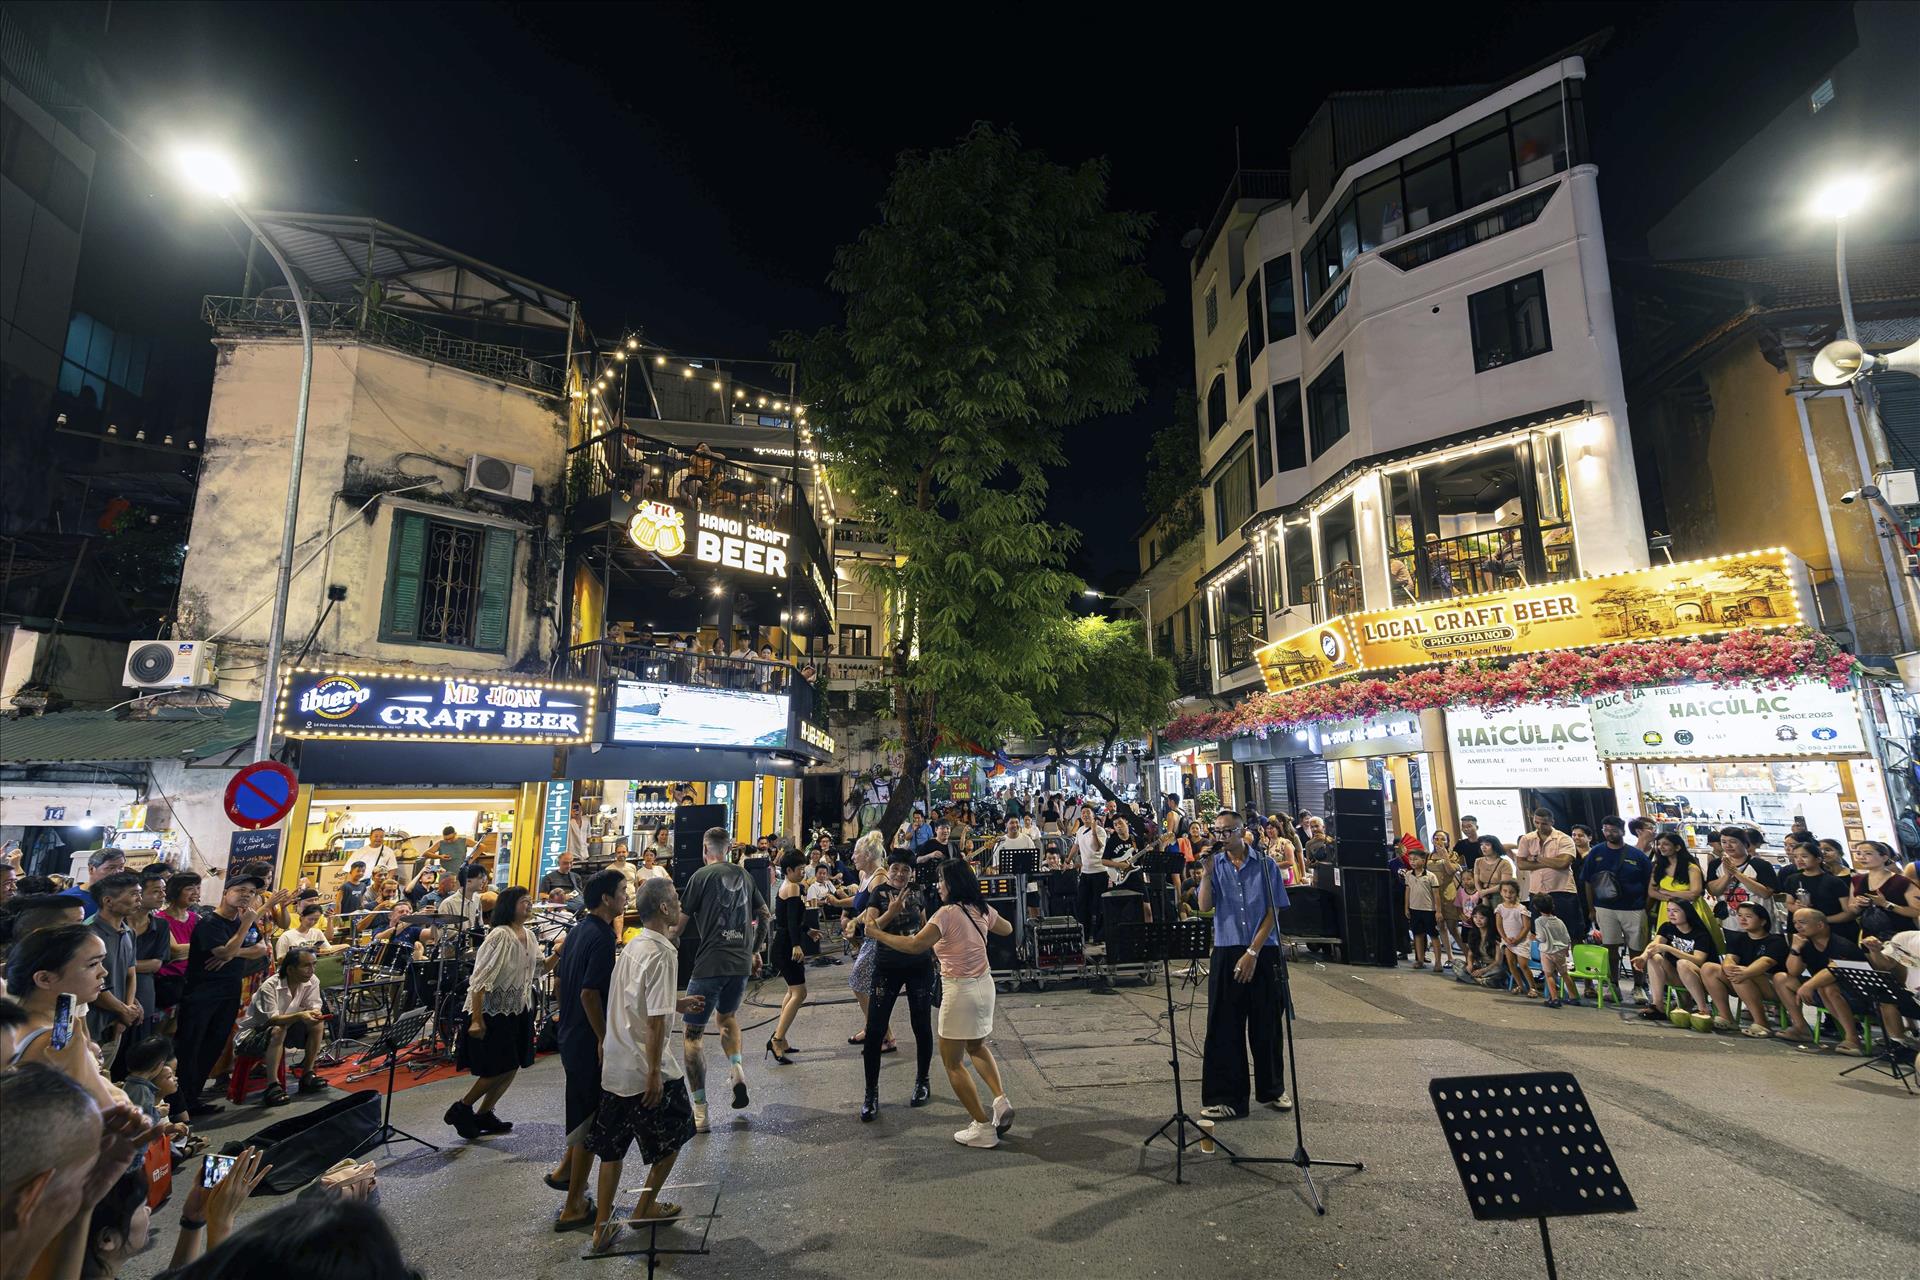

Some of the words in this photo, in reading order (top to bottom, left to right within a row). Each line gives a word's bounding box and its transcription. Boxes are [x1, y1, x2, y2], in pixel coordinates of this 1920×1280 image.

[653, 503, 671, 517] TK
[700, 513, 742, 536] HANOI
[747, 524, 790, 547] CRAFT
[697, 531, 787, 578] BEER
[1365, 617, 1428, 641] LOCAL
[1434, 606, 1504, 631] CRAFT
[1514, 597, 1576, 621] BEER
[1454, 649, 1468, 658] The
[1469, 646, 1492, 657] Local
[1493, 644, 1512, 655] Way
[379, 706, 495, 731] CRAFT
[501, 711, 580, 734] BEER
[1808, 711, 1834, 719] 2023
